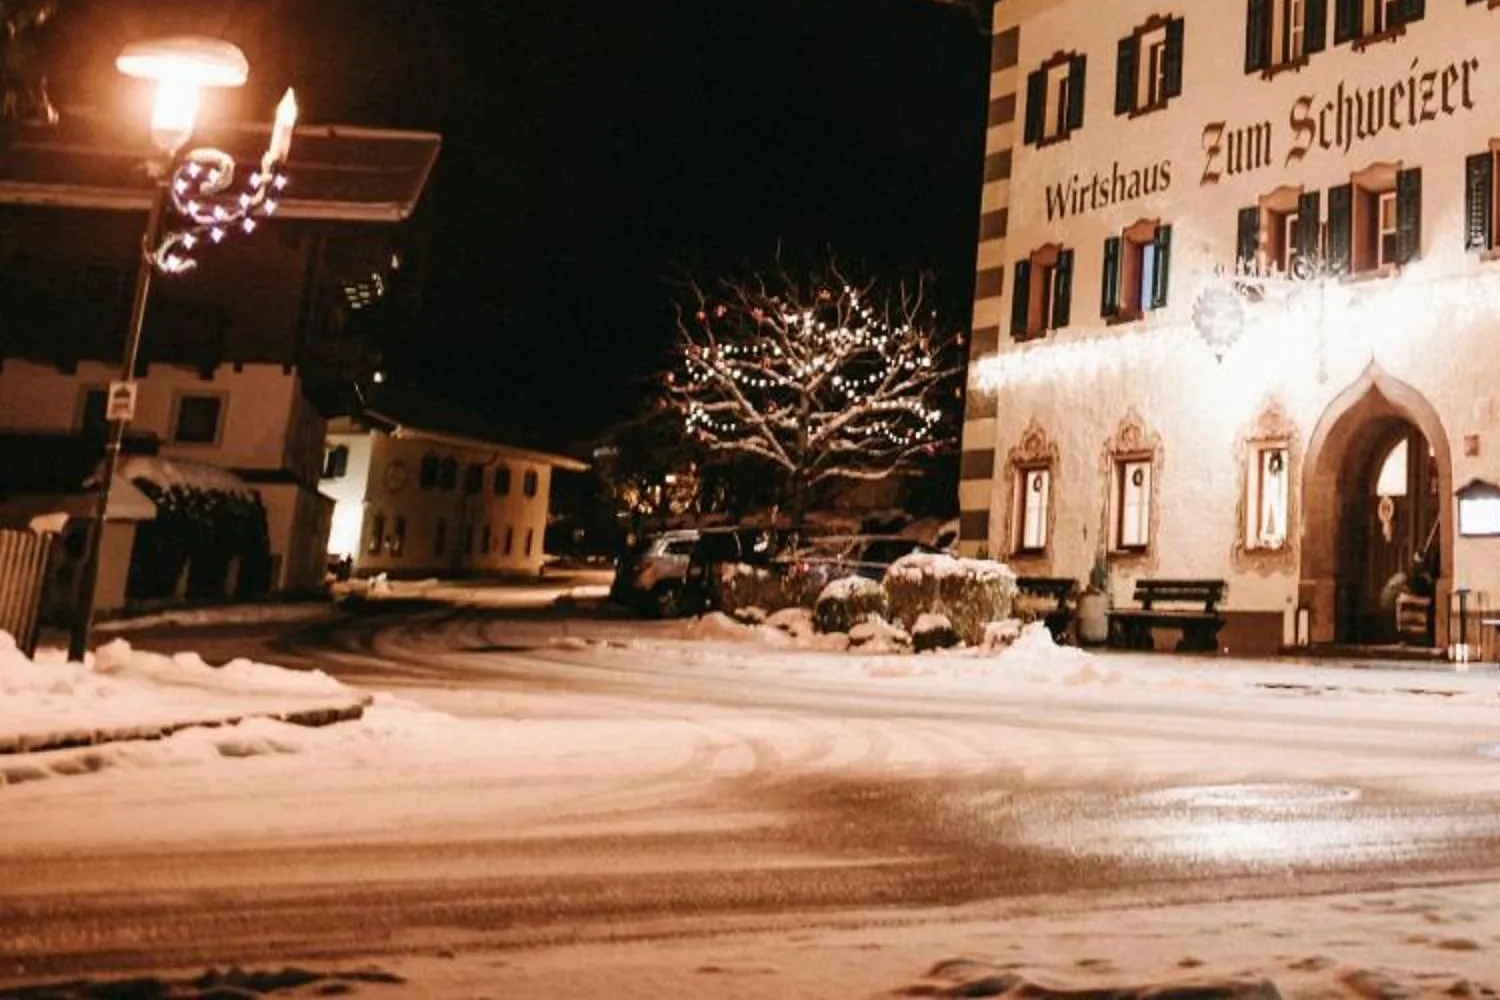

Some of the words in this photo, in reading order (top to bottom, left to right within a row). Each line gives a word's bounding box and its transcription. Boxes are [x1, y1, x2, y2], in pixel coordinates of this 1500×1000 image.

[1045, 160, 1172, 223] Wirtshaus
[1200, 118, 1272, 187] Zum
[1284, 55, 1480, 169] Schweizer
